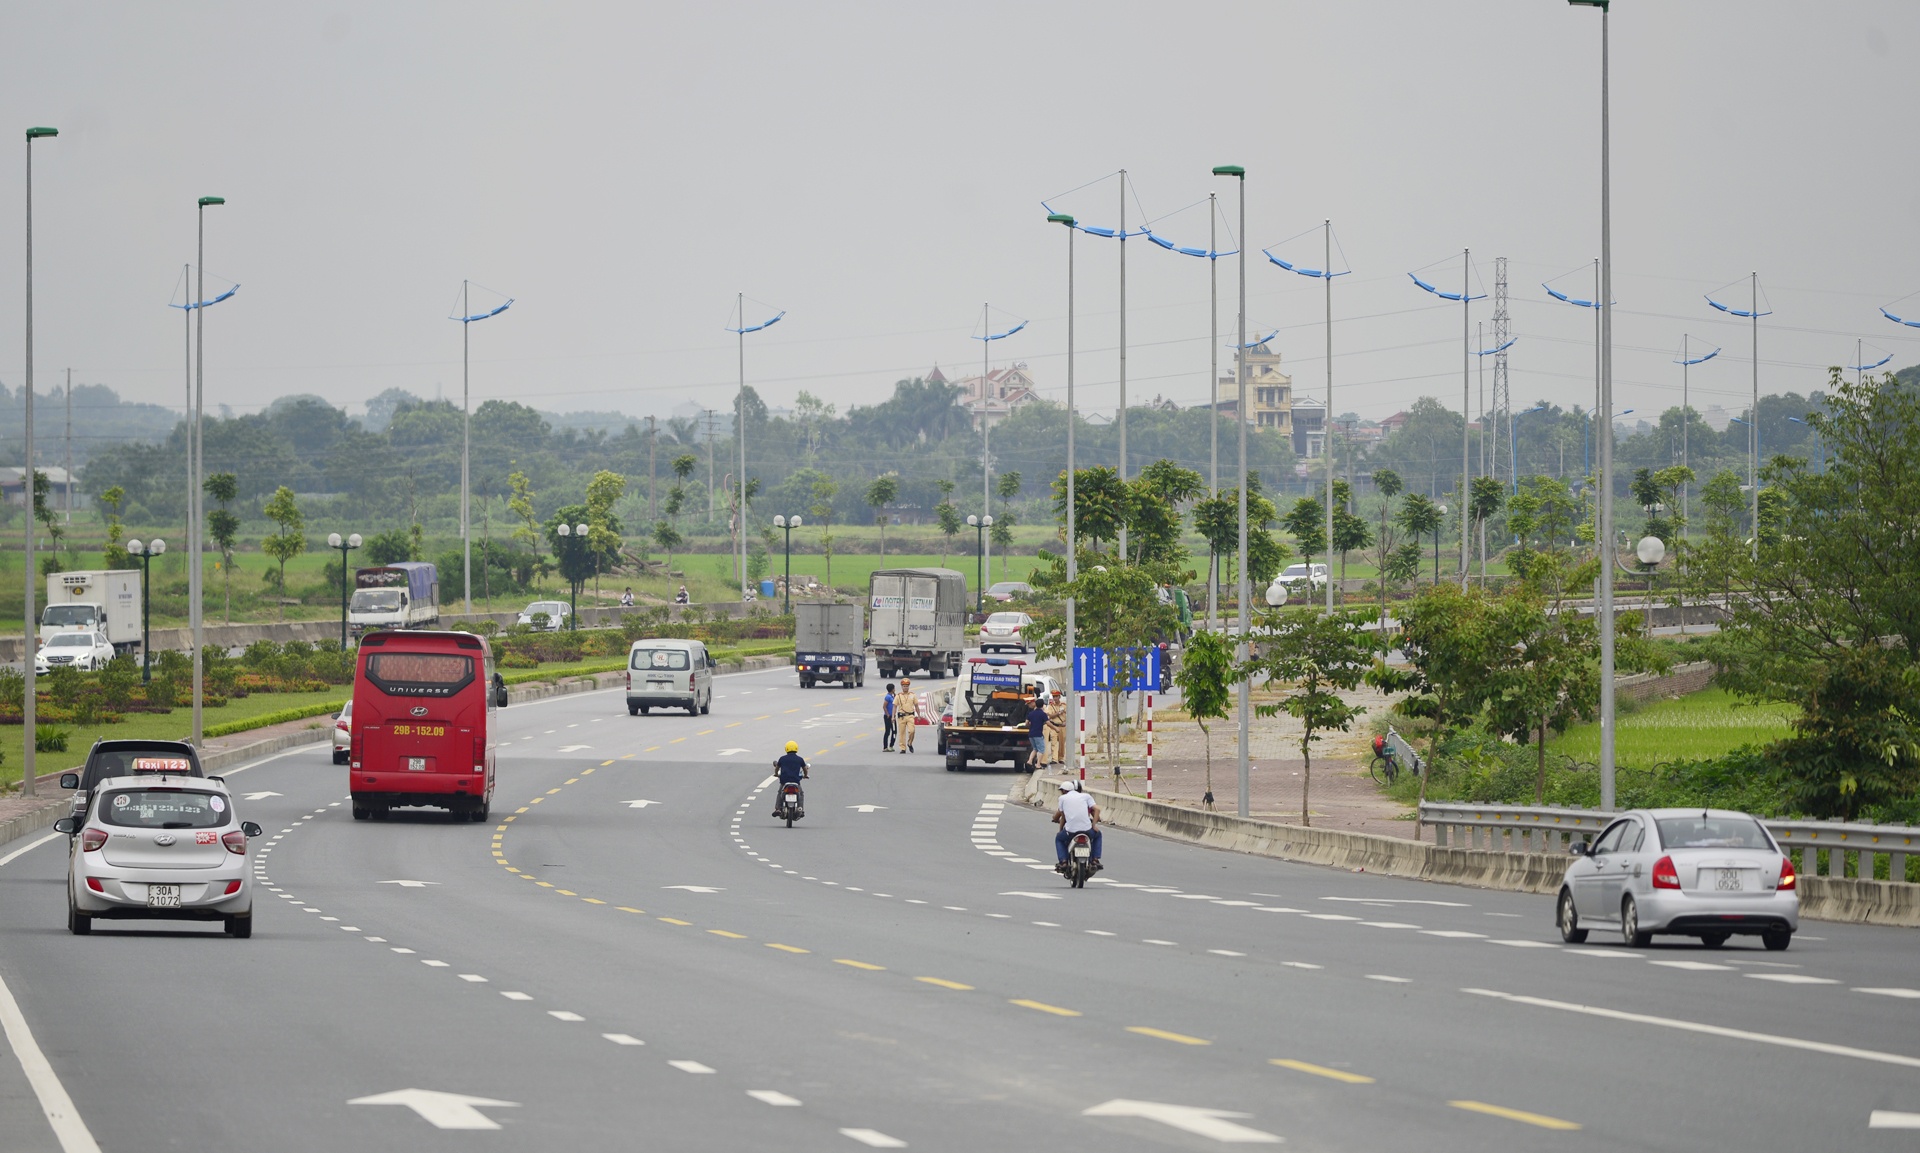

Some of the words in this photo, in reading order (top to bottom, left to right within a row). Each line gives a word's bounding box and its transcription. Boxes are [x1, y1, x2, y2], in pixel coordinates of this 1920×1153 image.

[911, 598, 933, 609] VIETNAM
[394, 725, 410, 735] 29B
[416, 726, 444, 736] 152.09
[138, 760, 160, 770] Taxi
[163, 760, 187, 770] 123
[1721, 870, 1737, 879] 30U
[1718, 880, 1740, 890] 0525
[156, 886, 172, 896] 30A
[149, 896, 179, 906] 210.72
